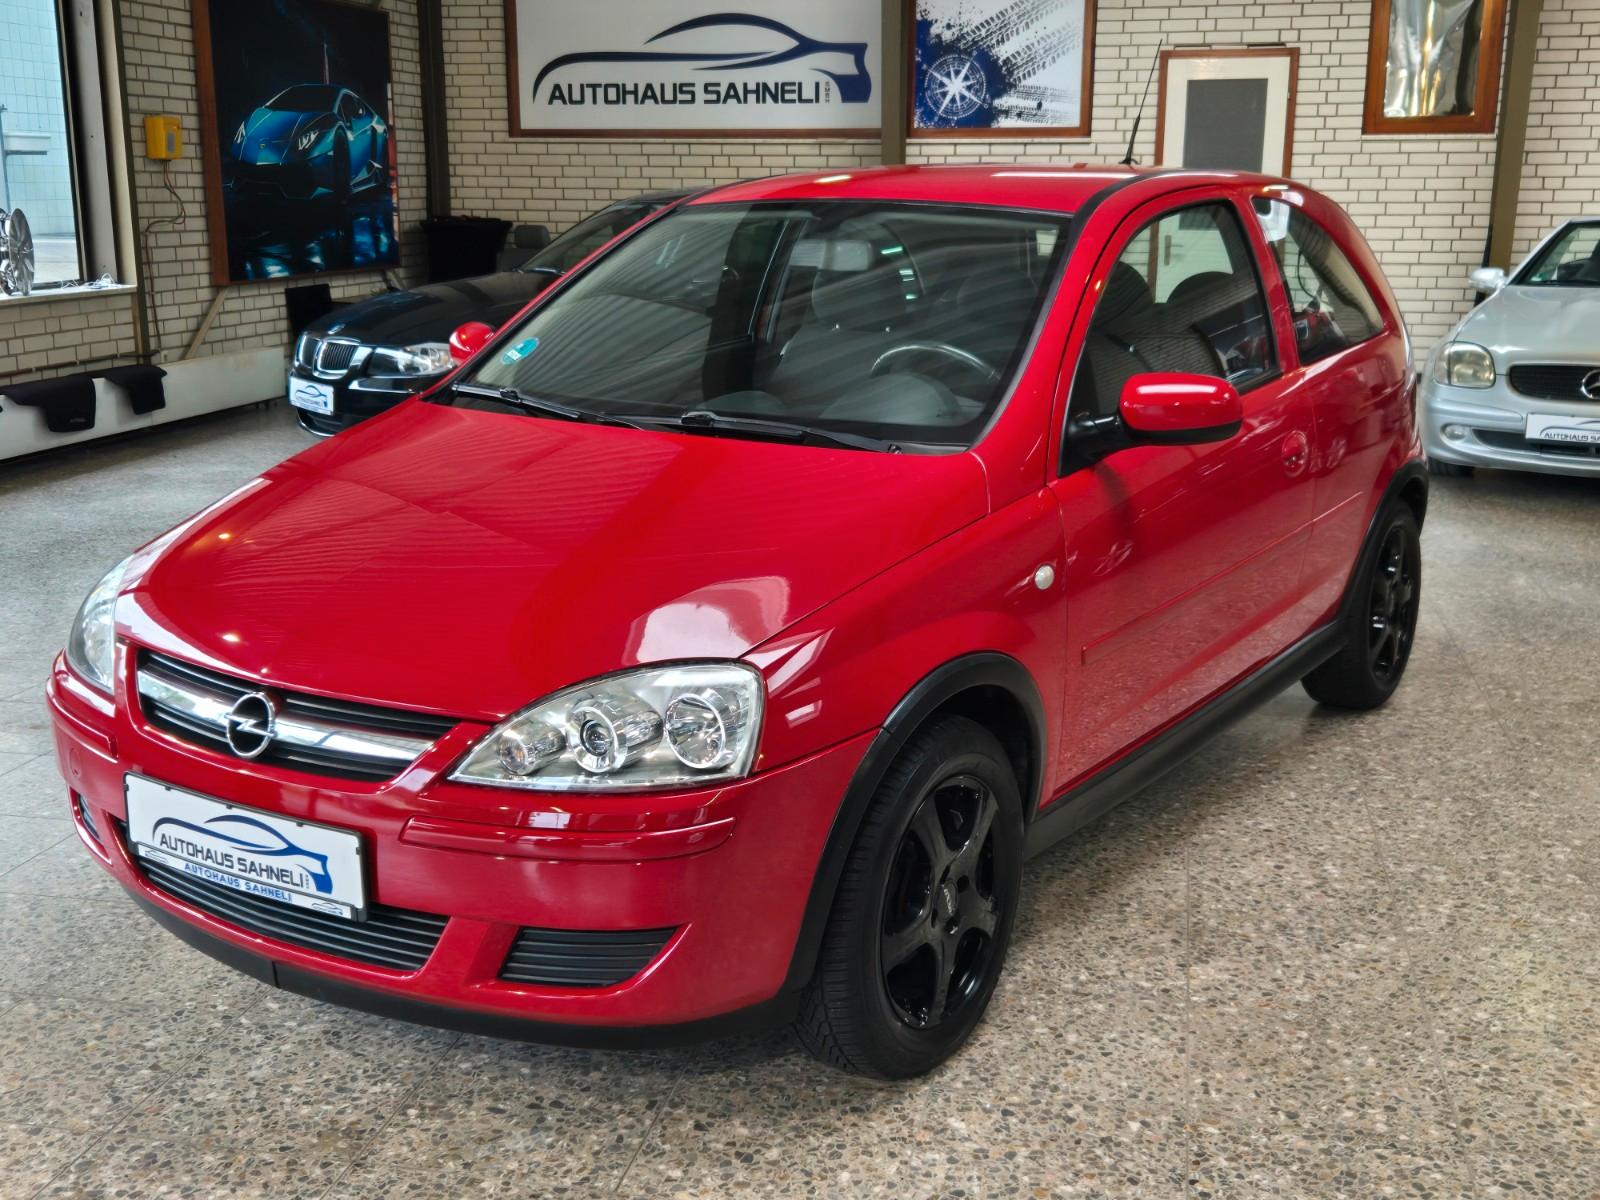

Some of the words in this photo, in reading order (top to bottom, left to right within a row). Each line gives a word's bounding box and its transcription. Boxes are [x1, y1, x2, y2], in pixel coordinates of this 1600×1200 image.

[548, 82, 696, 105] AUTOHAUS
[703, 81, 820, 104] SAHNELI
[1544, 432, 1589, 441] AUTOHAUS
[160, 833, 234, 869] AUTOHAUS
[237, 857, 304, 888] SAHNELI
[184, 863, 241, 887] AUTOHAUS
[245, 881, 292, 902] SAHNELI
